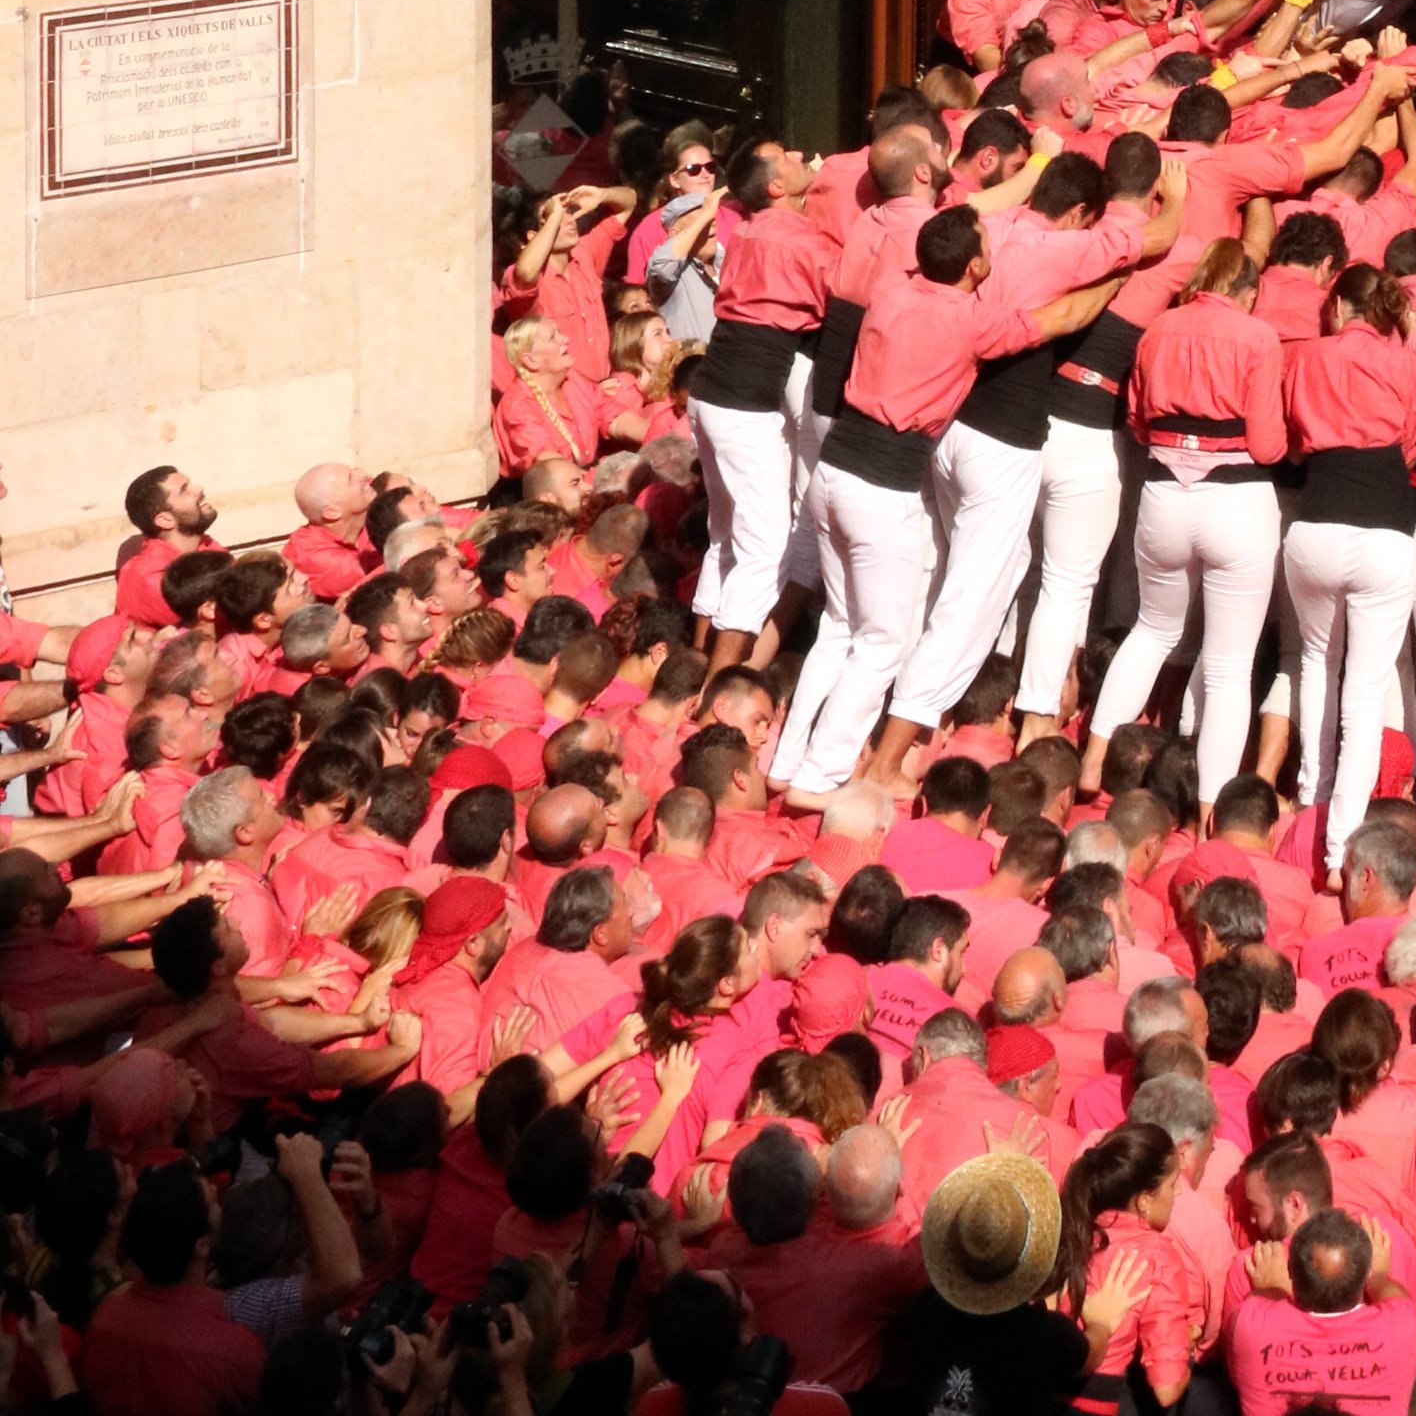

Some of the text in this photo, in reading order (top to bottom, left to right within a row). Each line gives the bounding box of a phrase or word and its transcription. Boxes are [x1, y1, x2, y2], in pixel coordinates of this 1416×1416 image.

[69, 39, 85, 50] LA
[87, 34, 127, 47] CIUTAT
[138, 29, 162, 42] ELS
[167, 21, 219, 38] XIQUETS
[221, 19, 236, 31] DE
[238, 14, 274, 28] VALLS
[118, 53, 131, 66] En
[207, 41, 219, 54] de
[222, 40, 231, 52] la
[1324, 947, 1368, 972] TOTS
[1259, 1339, 1313, 1365] TOTS
[1264, 1363, 1387, 1385] COLLA VELLA
